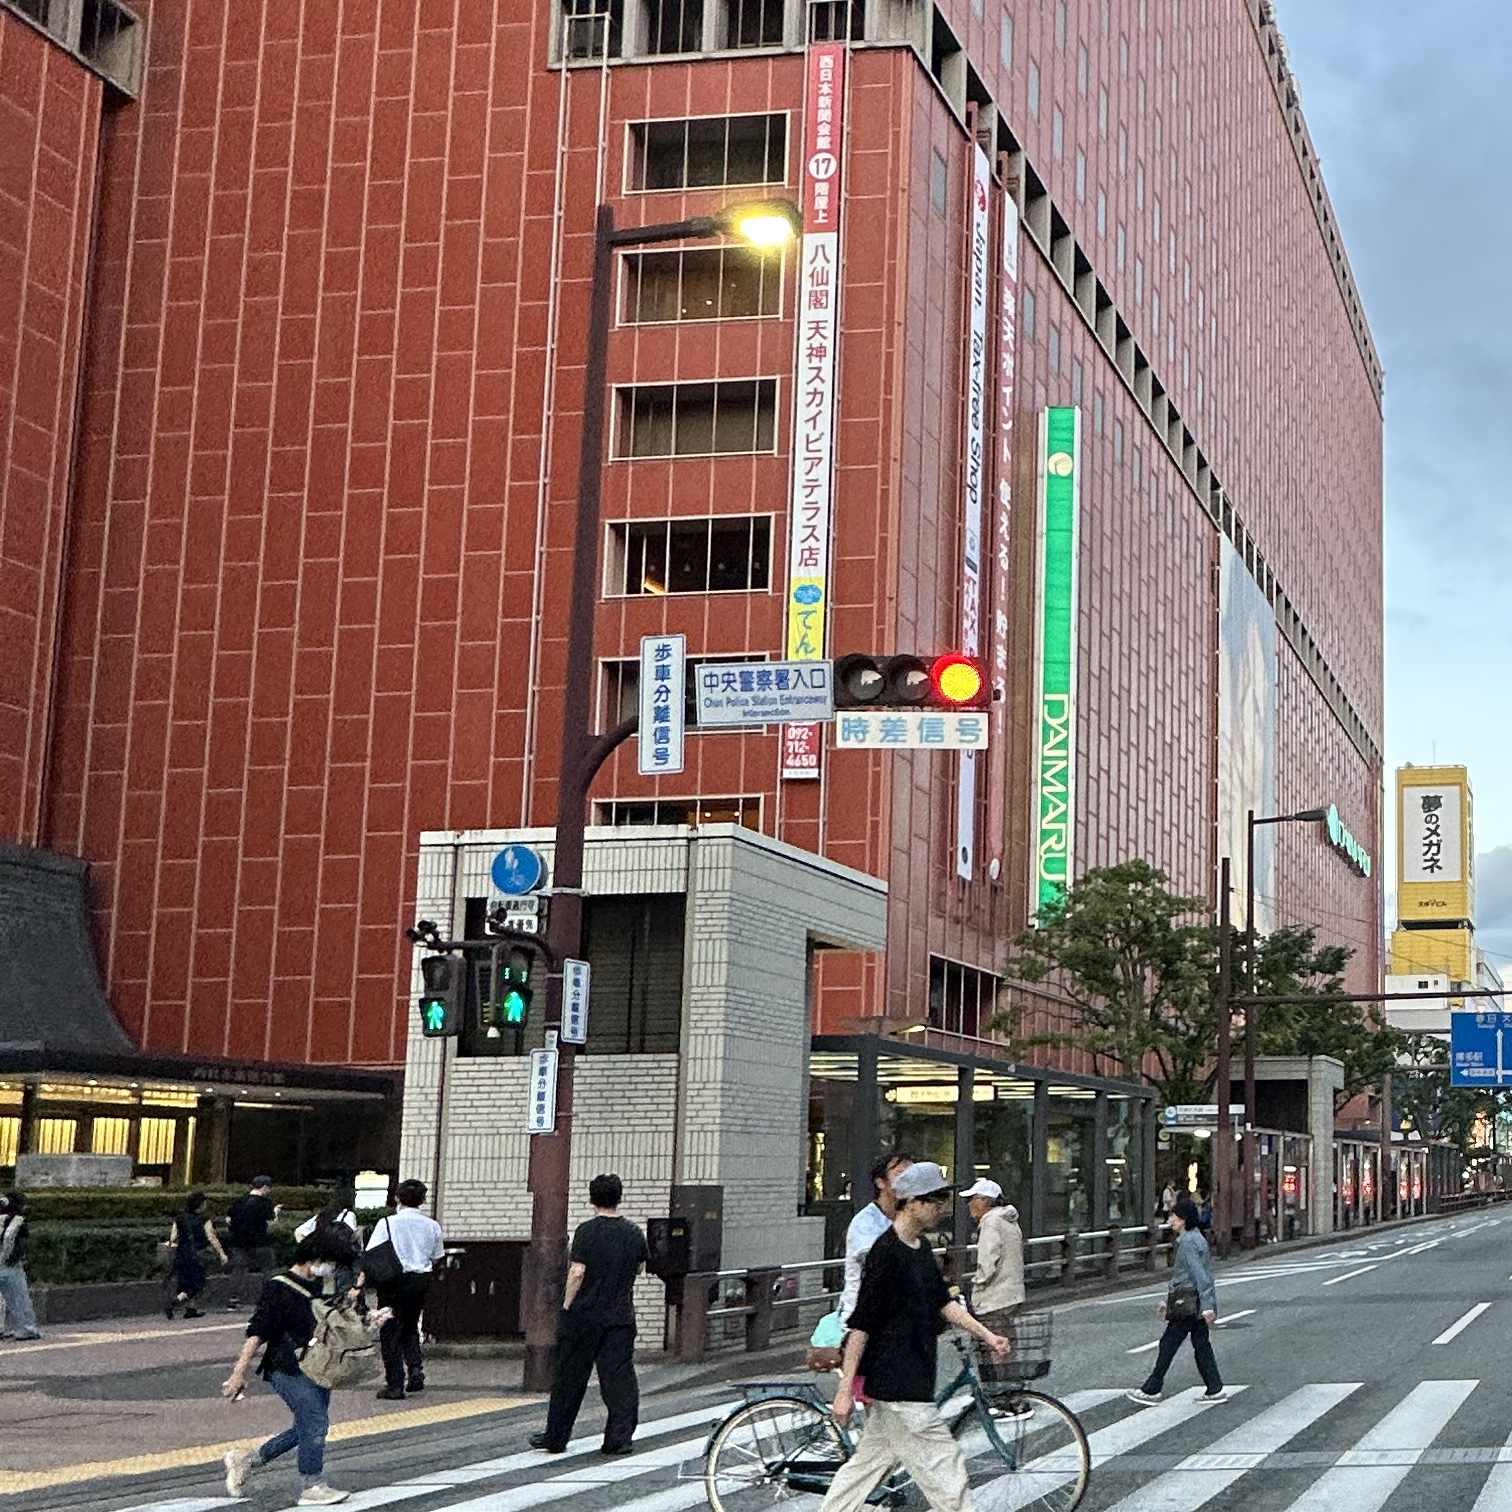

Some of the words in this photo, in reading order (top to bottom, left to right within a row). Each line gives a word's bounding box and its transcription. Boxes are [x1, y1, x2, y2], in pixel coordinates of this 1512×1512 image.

[808, 244, 831, 311] 八仙閣
[797, 319, 829, 567] 天神スカイビアテラス店
[967, 438, 983, 504] Shop
[652, 643, 672, 766] 歩車分離信号
[703, 668, 826, 694] 中央警察署入口
[841, 715, 983, 744] 時差信号
[1040, 693, 1069, 881] DAIMARU
[1421, 794, 1444, 874] 夢のメガネ
